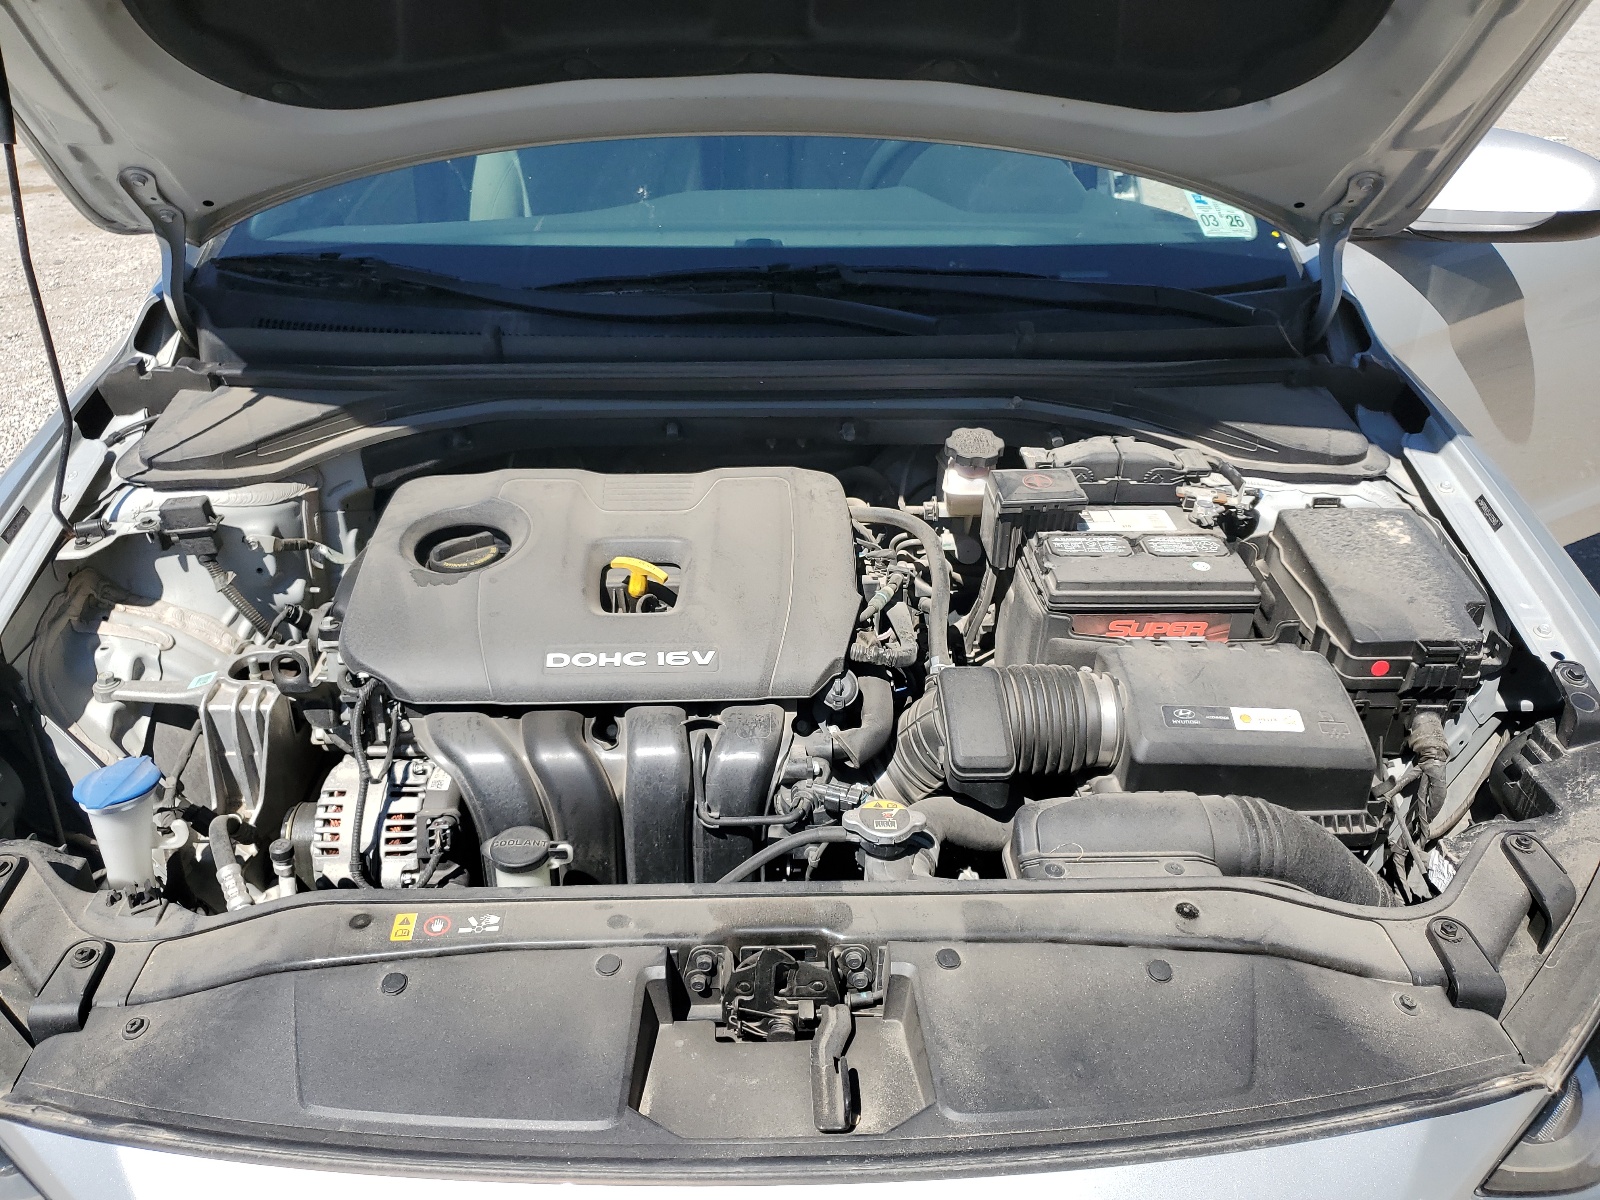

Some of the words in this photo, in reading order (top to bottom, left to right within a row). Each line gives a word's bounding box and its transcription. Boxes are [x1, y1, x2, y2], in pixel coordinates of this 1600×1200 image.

[1201, 214, 1219, 227] 03
[1226, 214, 1244, 227] 26
[1106, 620, 1208, 637] SUPER
[546, 651, 647, 668] DOHC
[657, 651, 715, 666] 16V
[492, 839, 548, 848] COOLANT
